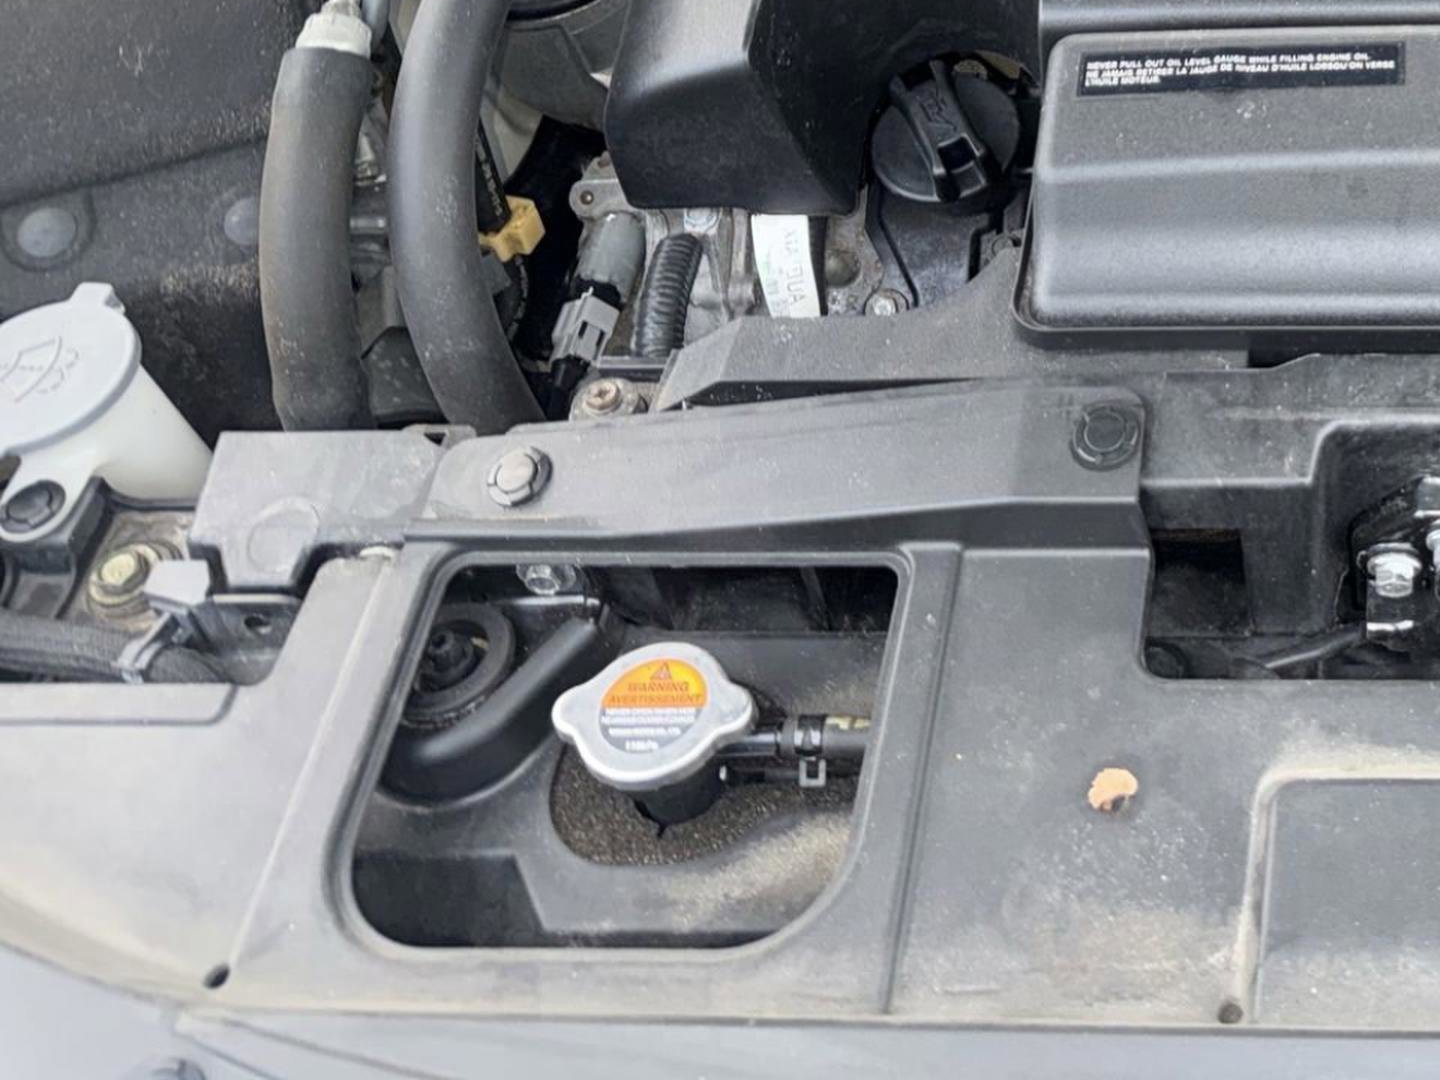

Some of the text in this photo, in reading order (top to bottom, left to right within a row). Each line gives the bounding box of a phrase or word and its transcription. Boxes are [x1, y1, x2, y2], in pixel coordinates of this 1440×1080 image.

[1087, 61, 1117, 70] NEVER
[1119, 60, 1142, 69] PULL
[1144, 59, 1165, 67] OUT
[1166, 58, 1181, 67] OIL
[1184, 57, 1211, 66] LEVEL
[1214, 55, 1246, 64] GAUGE
[1249, 55, 1277, 63] WHILE
[1279, 53, 1314, 62] FILLING
[1316, 52, 1351, 61] ENGINE
[1086, 69, 1099, 78] NE
[1102, 68, 1133, 77] JAMAIS
[1136, 67, 1173, 76] RETIRER
[1176, 66, 1187, 75] LA
[1189, 65, 1218, 74] JAUGE
[1220, 63, 1233, 72] DE
[1235, 63, 1269, 73] NIVEAU
[1365, 60, 1395, 69] VERSE
[627, 681, 690, 692] WARNING
[609, 694, 702, 704] AVERTISSEMENT
